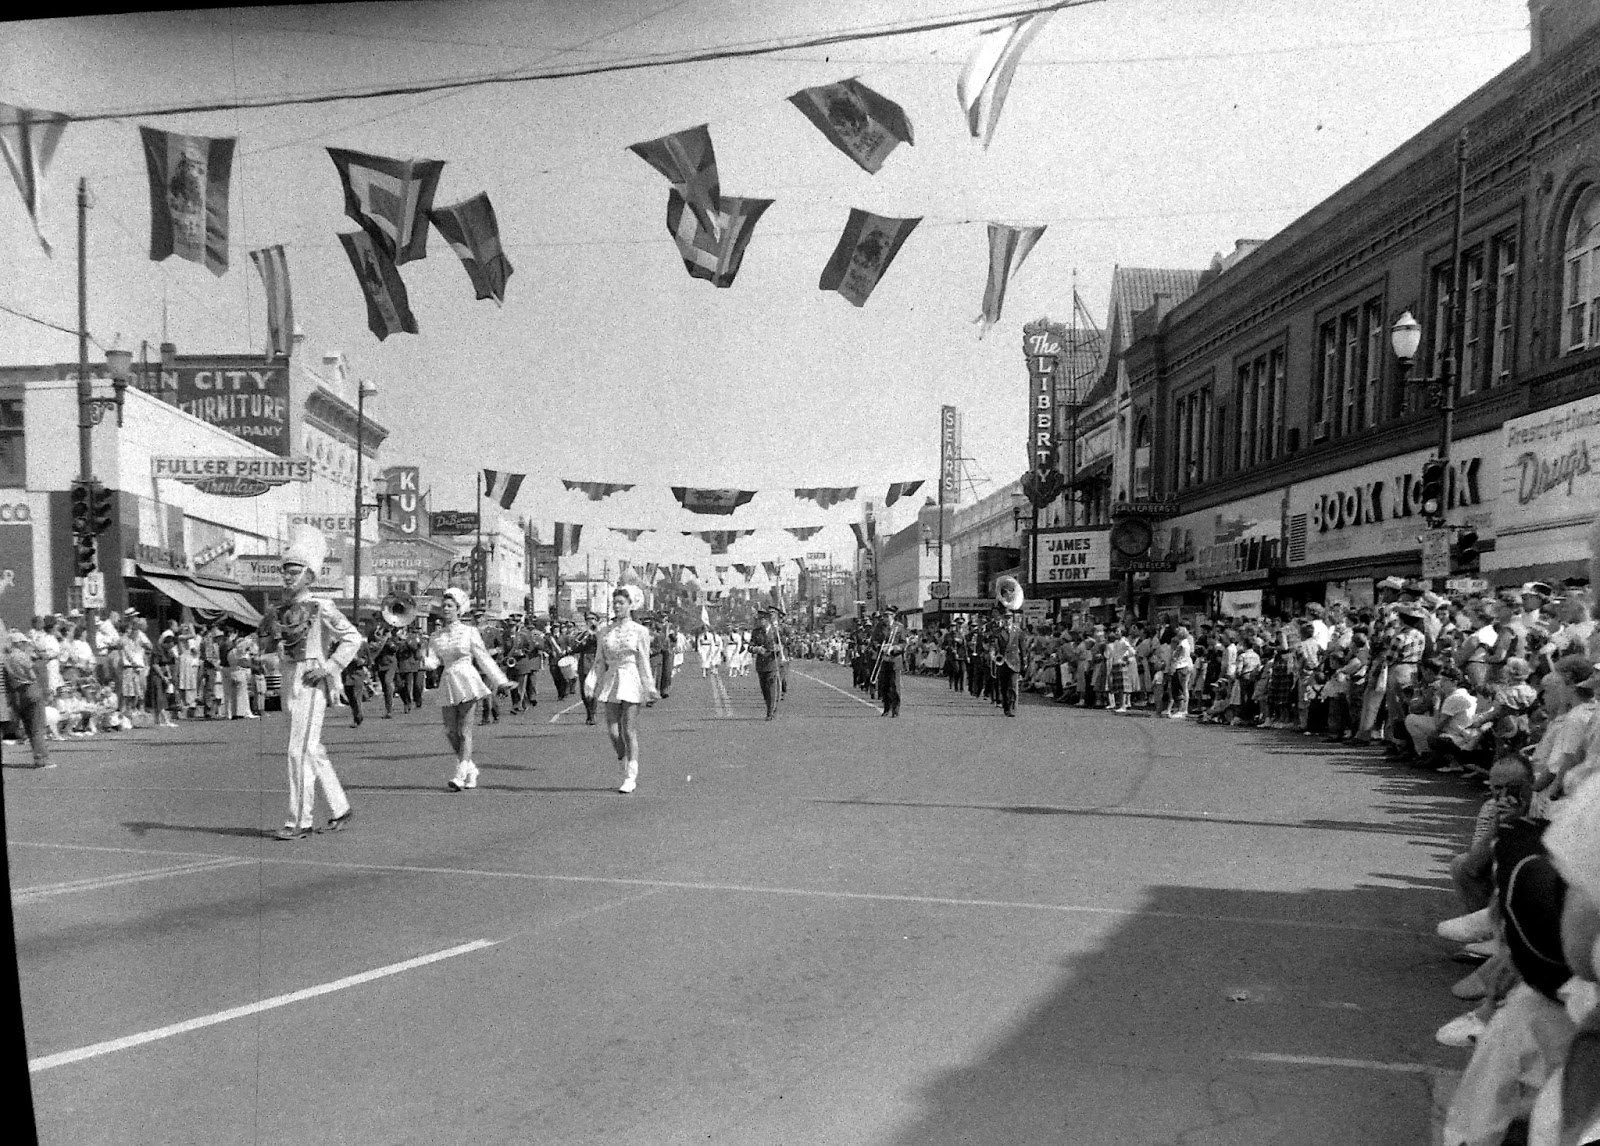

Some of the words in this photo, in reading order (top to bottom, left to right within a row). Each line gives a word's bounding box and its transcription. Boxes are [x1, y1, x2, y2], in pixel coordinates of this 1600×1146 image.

[1029, 331, 1062, 355] The
[194, 370, 274, 390] CITY
[179, 394, 285, 423] FURNITURE
[1037, 356, 1052, 483] LIBERTY
[945, 411, 954, 491] SEARS
[156, 458, 228, 475] FULLER
[236, 460, 308, 477] PAINTS
[1518, 439, 1591, 506] Drugs
[1309, 481, 1384, 532] BOOK
[1391, 457, 1481, 519] NOK
[1052, 552, 1087, 566] DEAN
